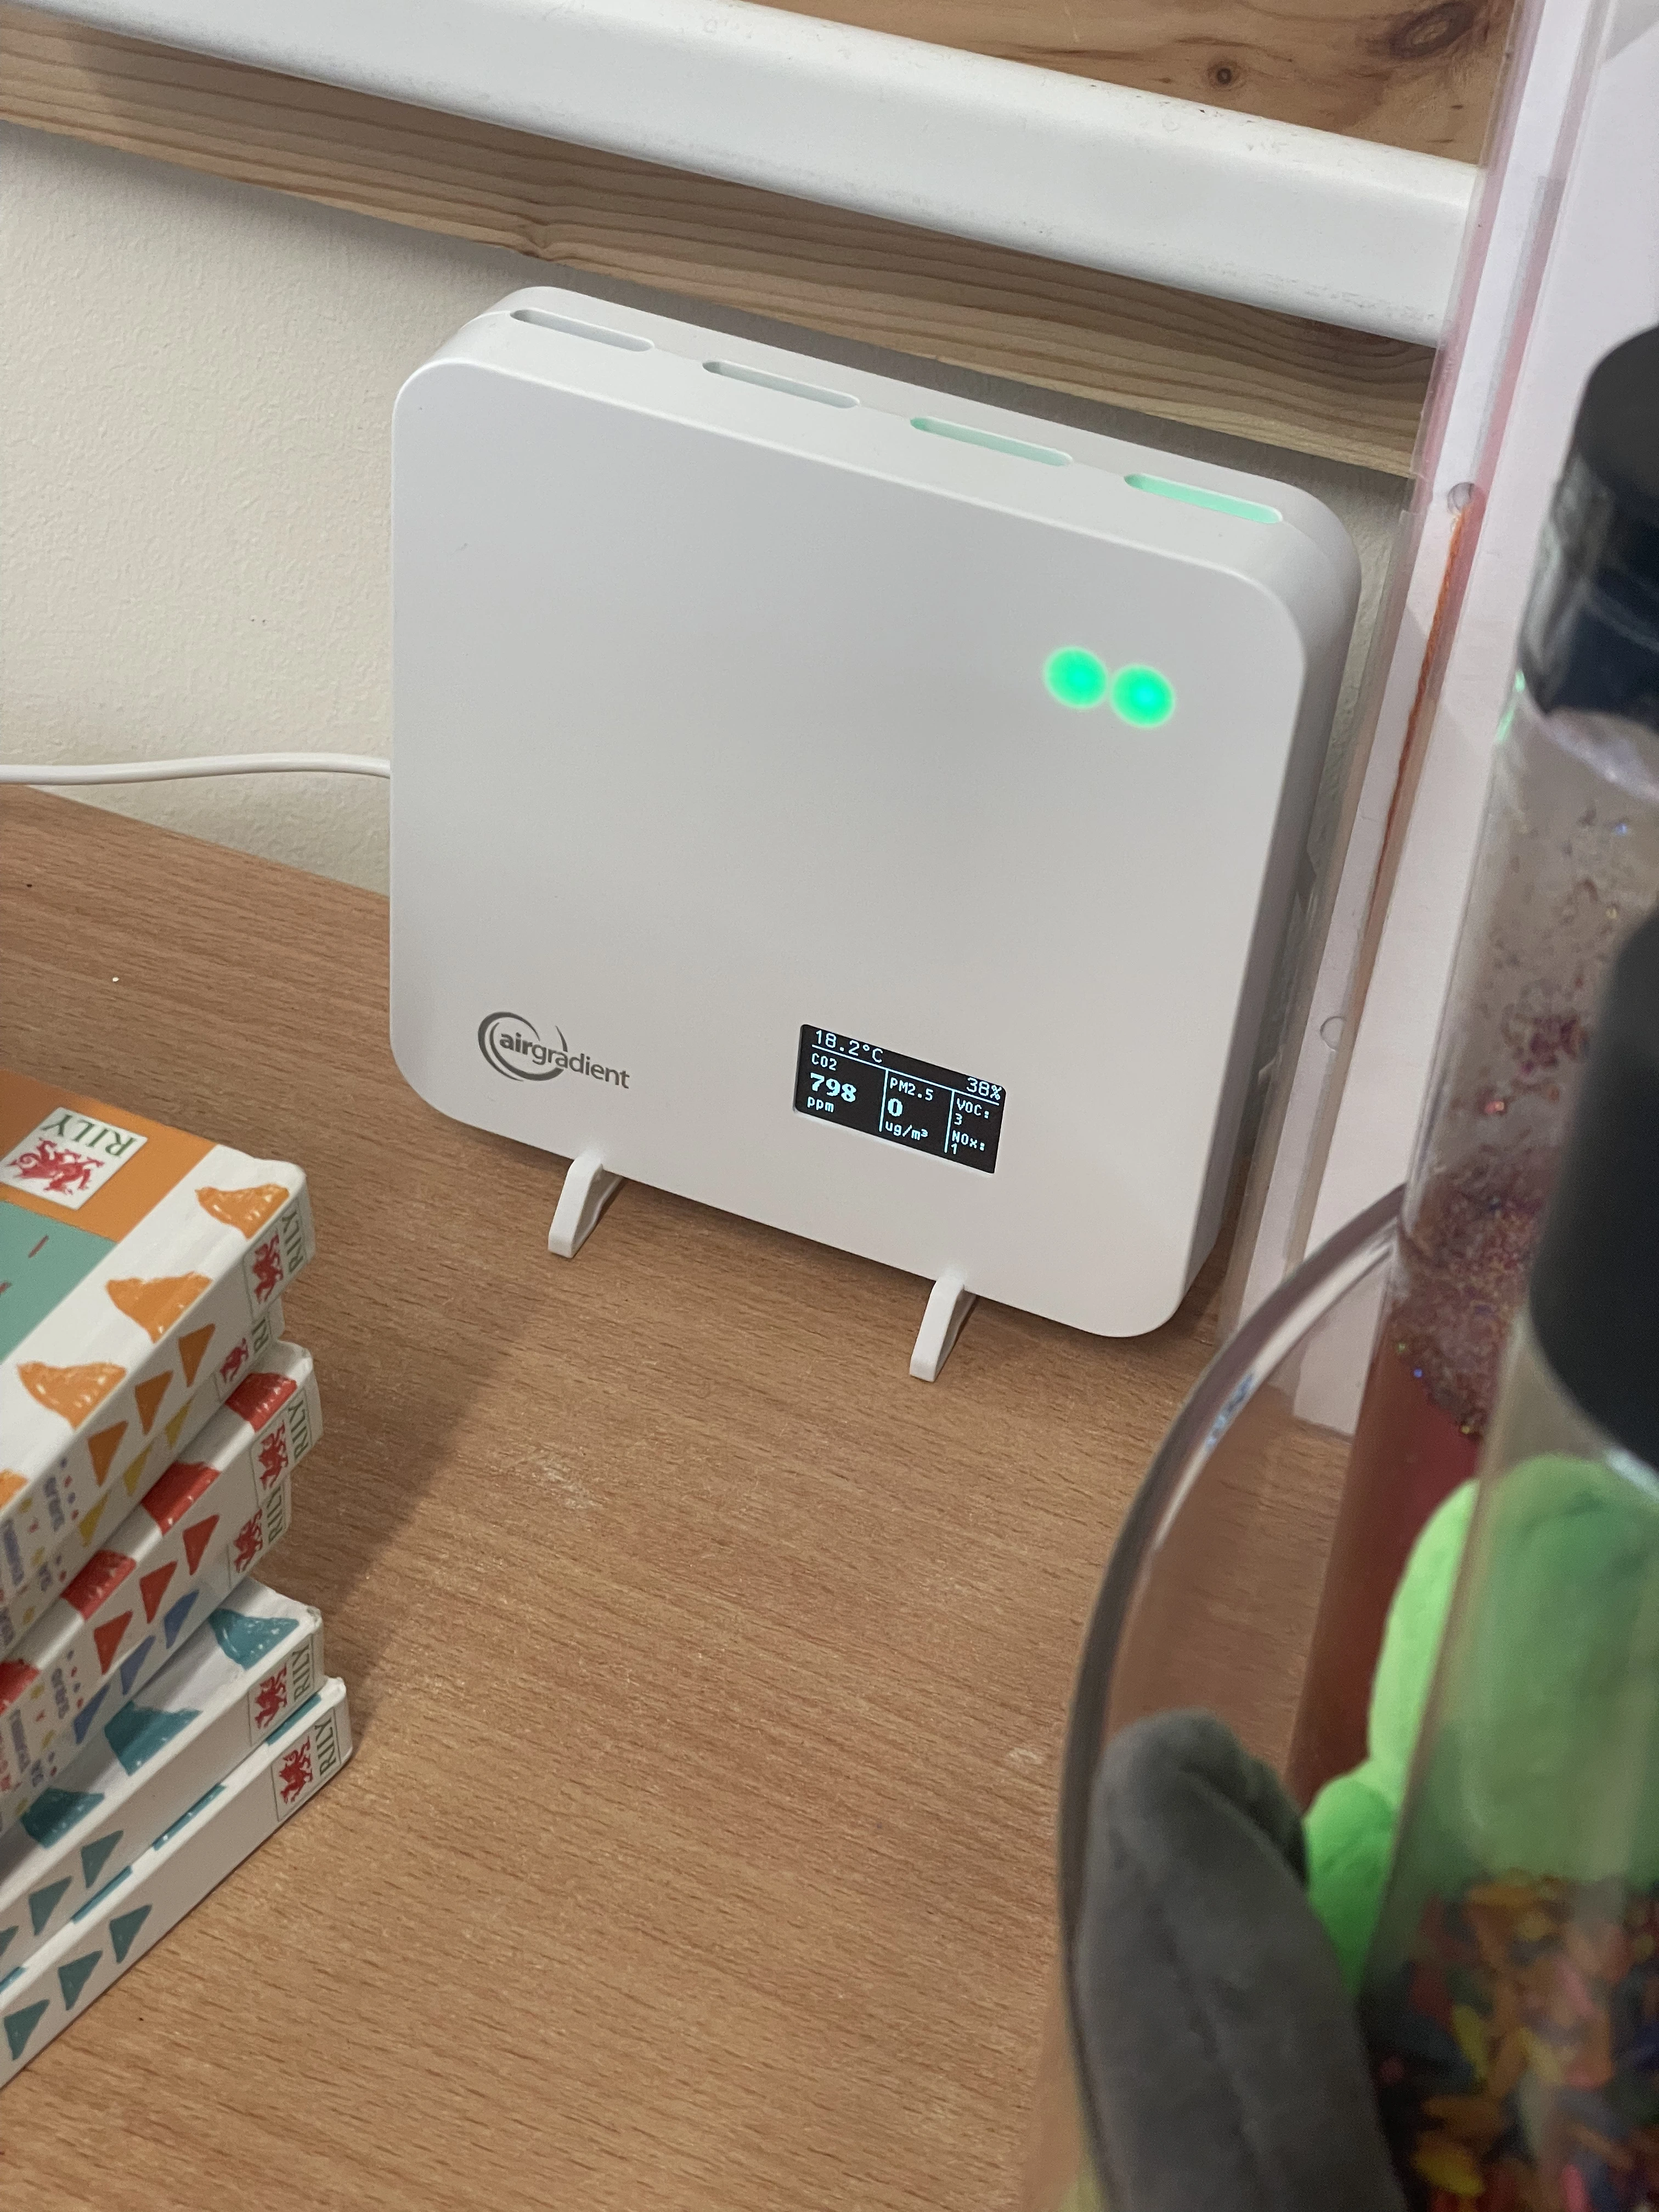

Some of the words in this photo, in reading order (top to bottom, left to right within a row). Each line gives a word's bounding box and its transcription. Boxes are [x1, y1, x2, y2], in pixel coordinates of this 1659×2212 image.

[499, 1032, 630, 1089] airgradient
[815, 1030, 884, 1063] 18.2°C
[811, 1053, 837, 1071] CO2
[810, 1073, 856, 1102] 798
[890, 1076, 934, 1102] PM2.5
[966, 1076, 1001, 1101] 38%
[807, 1096, 834, 1113] ppm
[887, 1098, 903, 1117] 0
[956, 1098, 990, 1119] VOC:
[953, 1113, 962, 1126] 3
[41, 1114, 137, 1158] RILY
[950, 1143, 957, 1155] 1
[281, 1210, 304, 1274] RILY
[251, 1317, 270, 1354] RI
[288, 1400, 309, 1462] RILY
[291, 1644, 311, 1702] RILY
[314, 1718, 337, 1777] RILY
